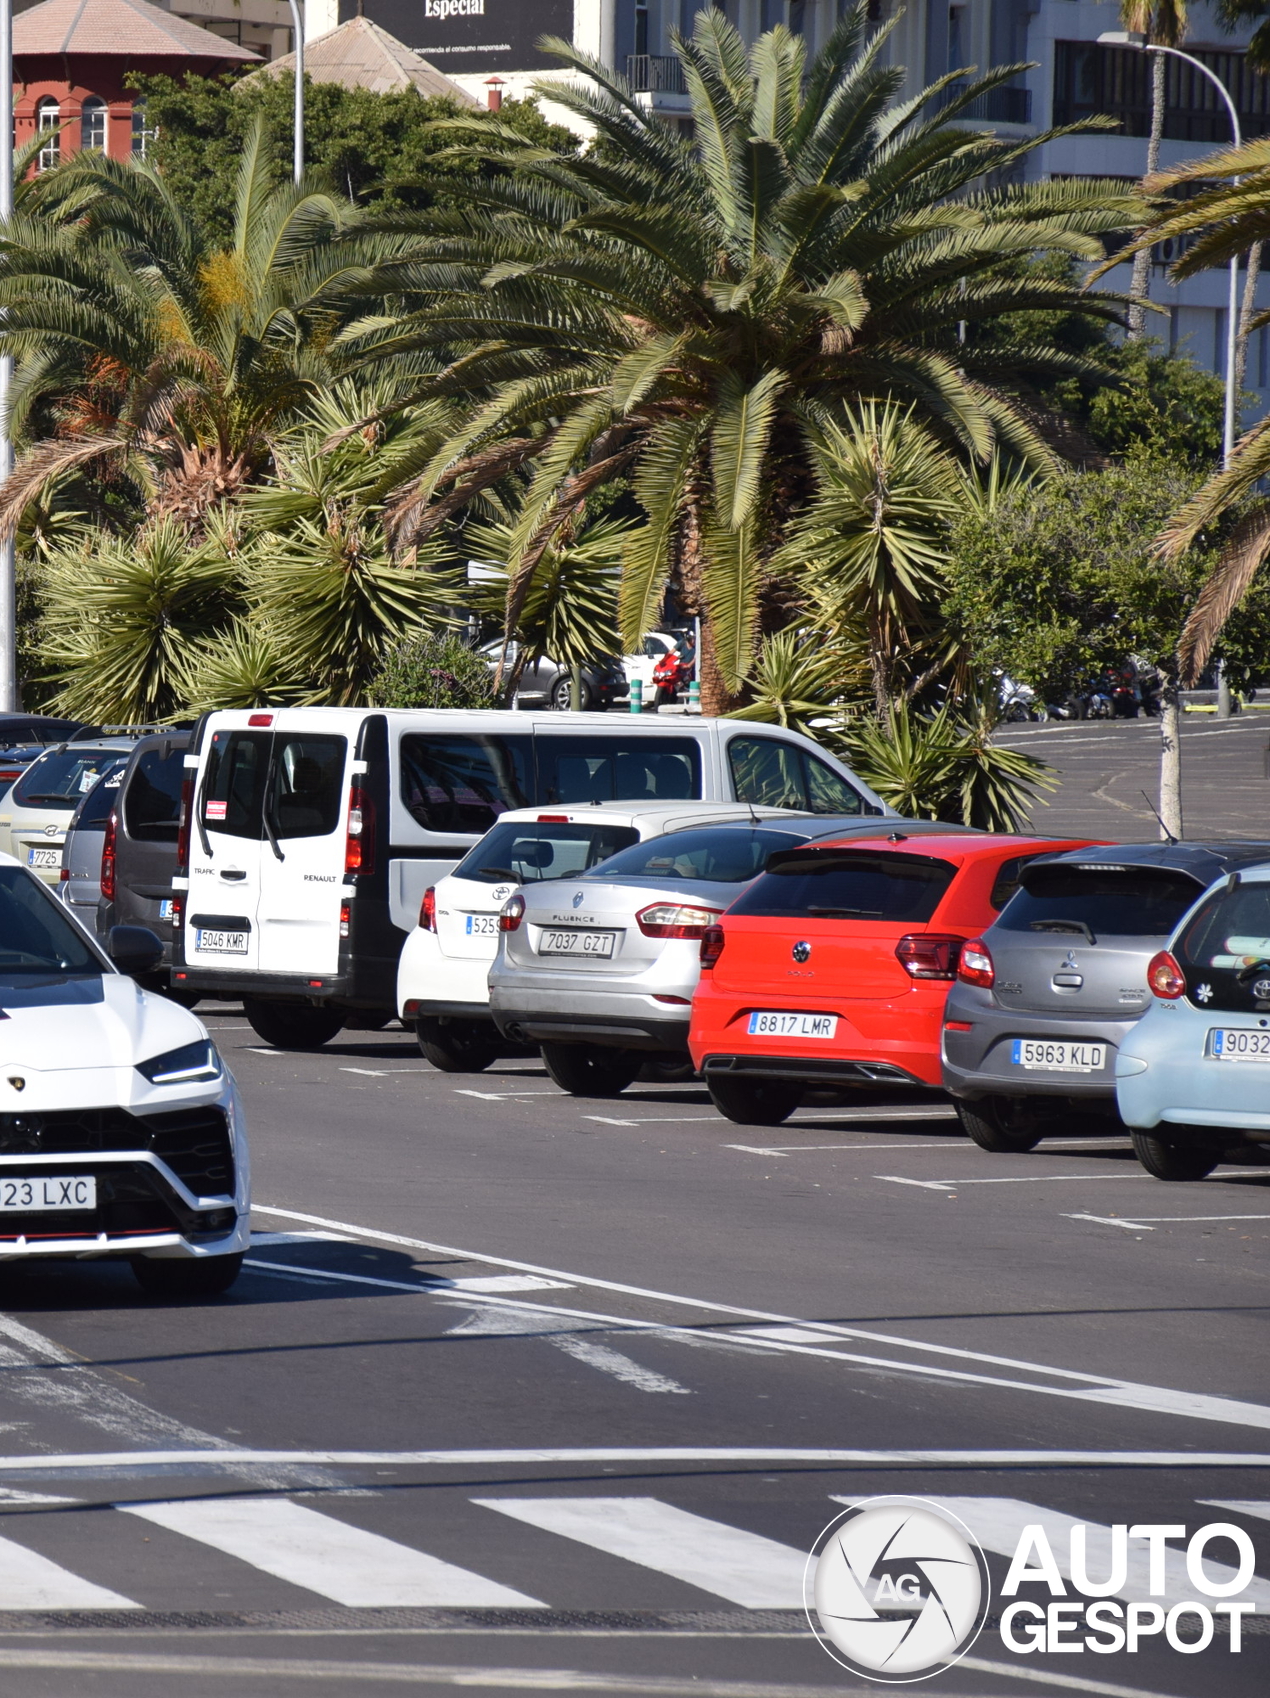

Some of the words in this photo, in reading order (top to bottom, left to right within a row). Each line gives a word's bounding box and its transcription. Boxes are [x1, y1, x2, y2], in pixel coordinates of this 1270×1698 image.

[425, 0, 484, 20] Especial
[452, 45, 477, 53] consumo
[34, 851, 57, 864] 7725
[194, 867, 215, 876] TRAFIC
[303, 874, 337, 883] RENAULT
[553, 914, 595, 923] FLUENCE
[202, 931, 224, 948] 5046
[226, 933, 244, 949] KMR
[549, 932, 578, 951] 7037
[583, 934, 610, 954] GZT
[759, 1015, 798, 1033] 8817
[801, 1017, 832, 1036] LMR
[1226, 1033, 1270, 1054] 9032
[1025, 1043, 1066, 1064] 5963
[1070, 1046, 1102, 1067] KLD
[43, 1180, 88, 1205] LXC
